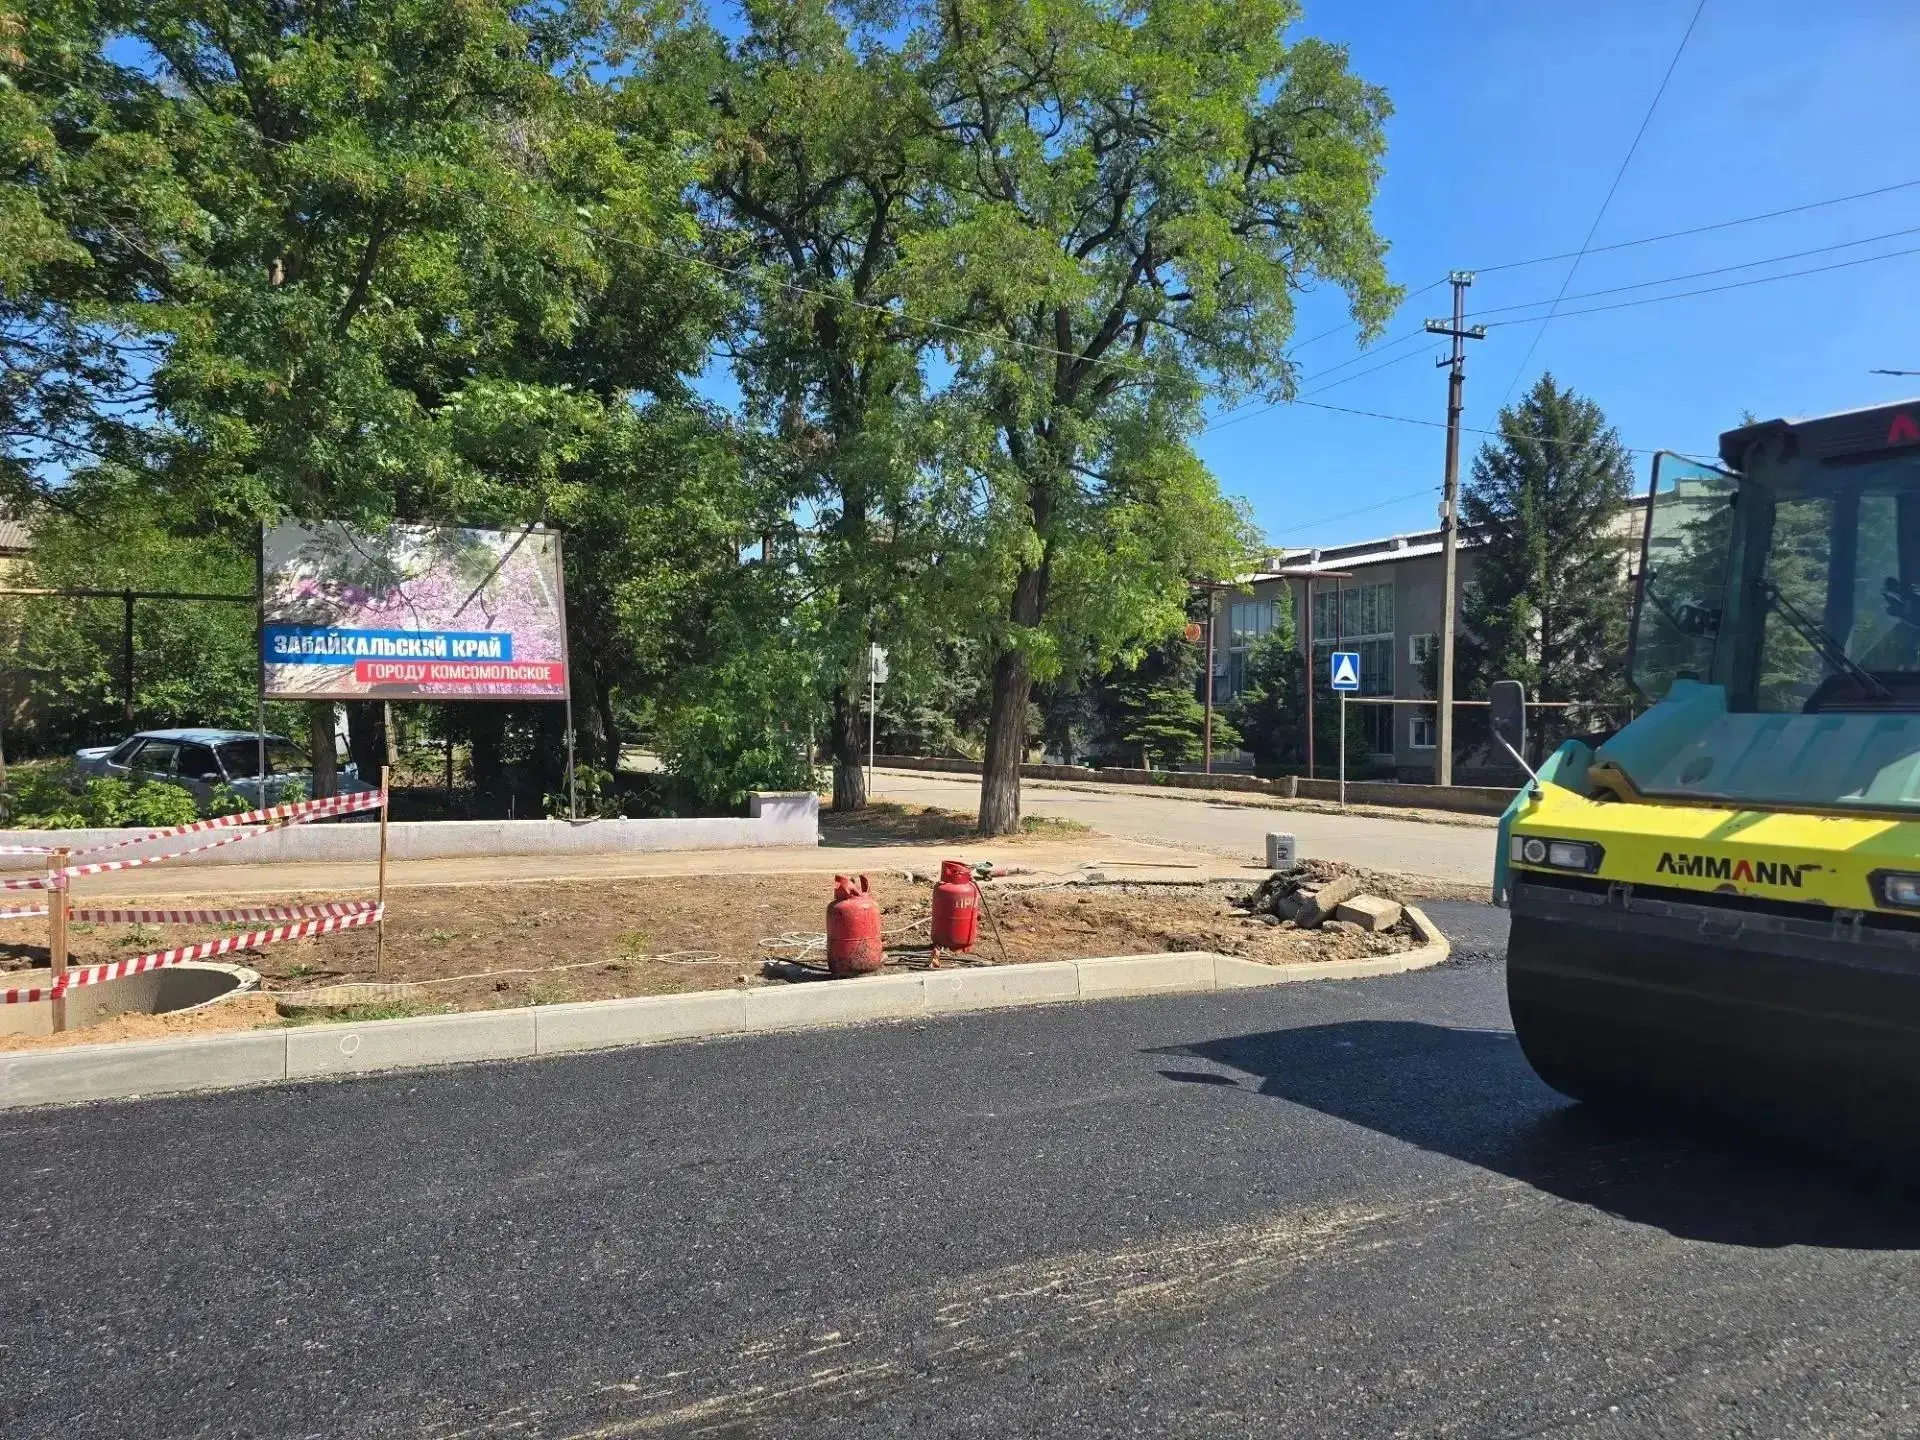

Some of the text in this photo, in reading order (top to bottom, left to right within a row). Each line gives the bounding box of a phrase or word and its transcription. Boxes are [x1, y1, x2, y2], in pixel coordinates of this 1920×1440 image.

[274, 632, 501, 658] ЗАБАЙКАЛЬСКИЙ КРАЙ
[366, 662, 552, 681] ГОРОДУ КОМСОМОЛЬСКОЕ
[1656, 852, 1802, 888] AMMANN
